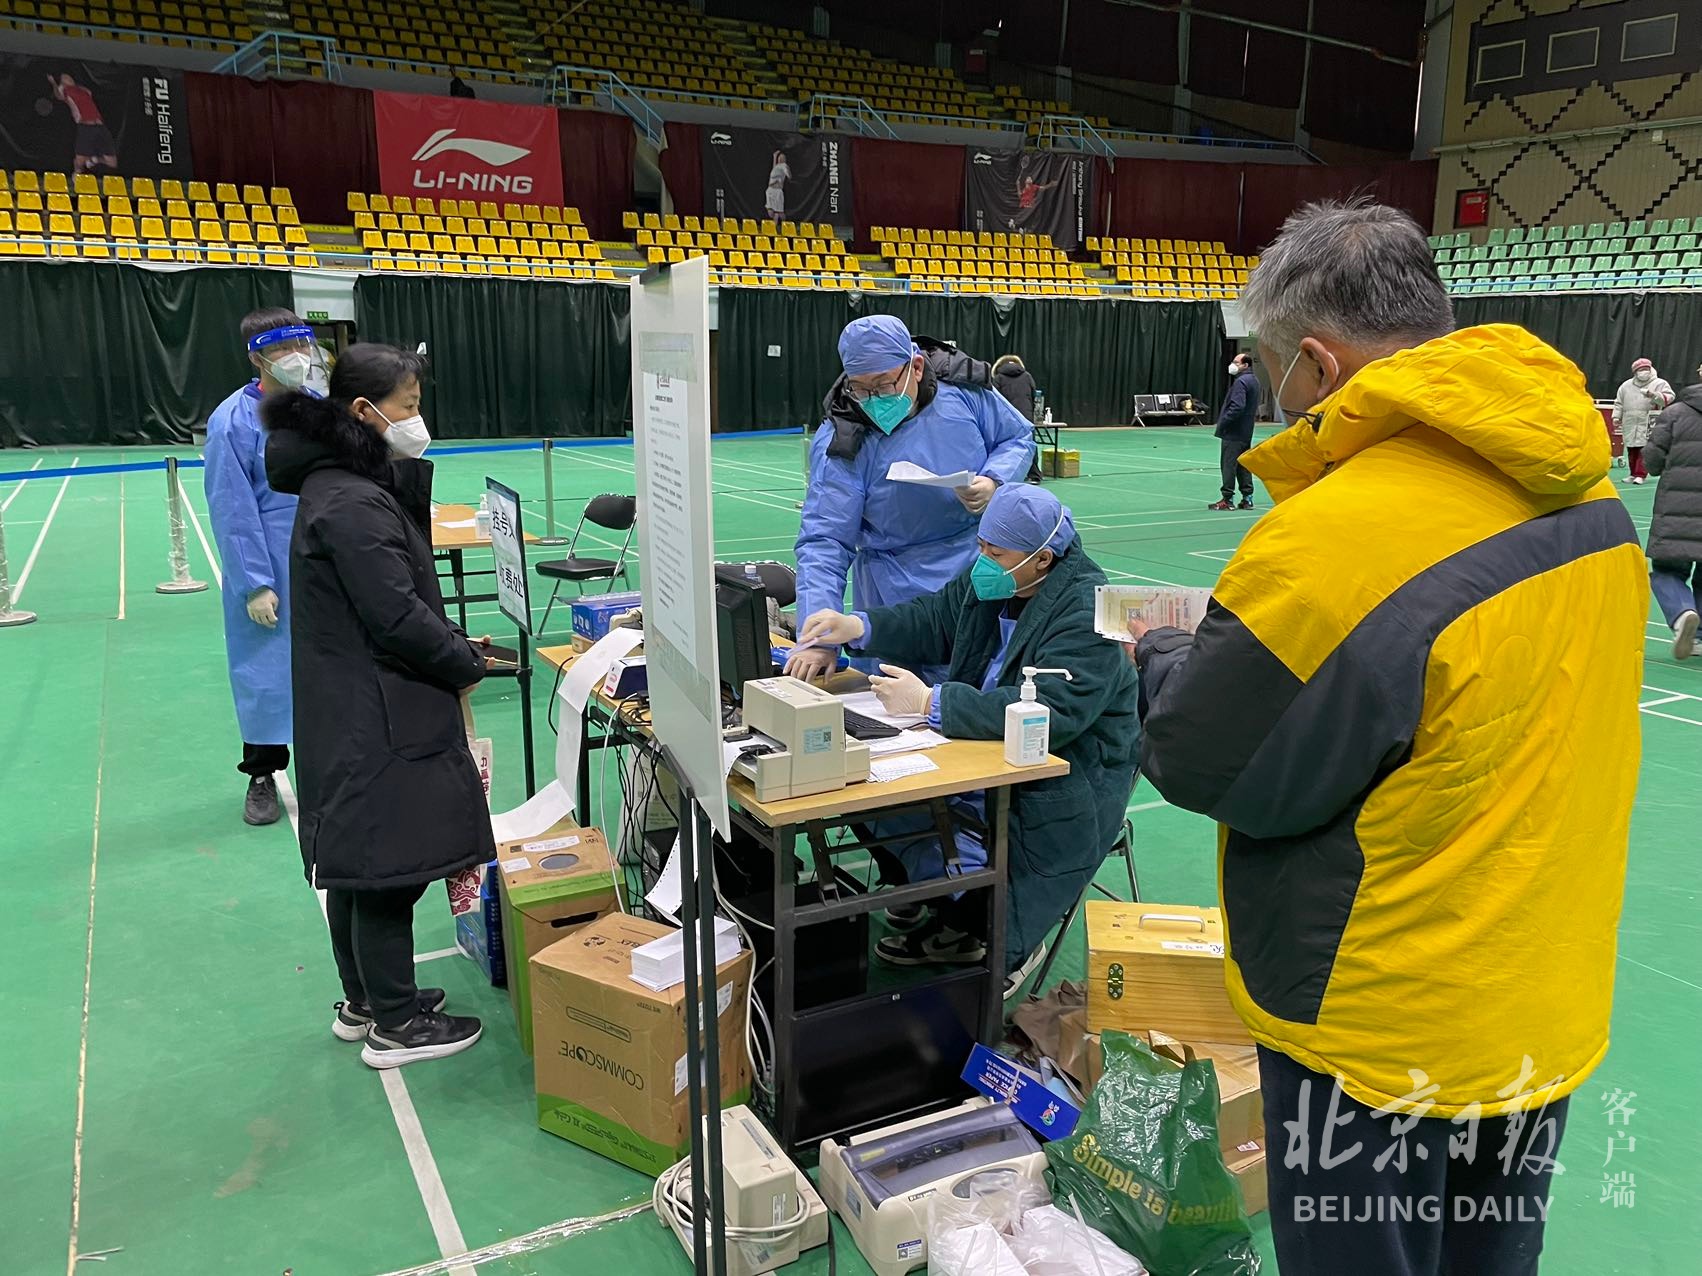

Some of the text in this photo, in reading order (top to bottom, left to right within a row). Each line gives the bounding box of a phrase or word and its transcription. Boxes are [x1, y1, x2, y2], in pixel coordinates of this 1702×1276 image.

[154, 77, 173, 165] FU Haifeng
[413, 169, 533, 194] LI-NING
[828, 141, 839, 214] ZHANG Nan
[559, 1040, 644, 1091] COMMSCOPE
[1072, 1134, 1143, 1200] Simple
[1143, 1188, 1168, 1216] is
